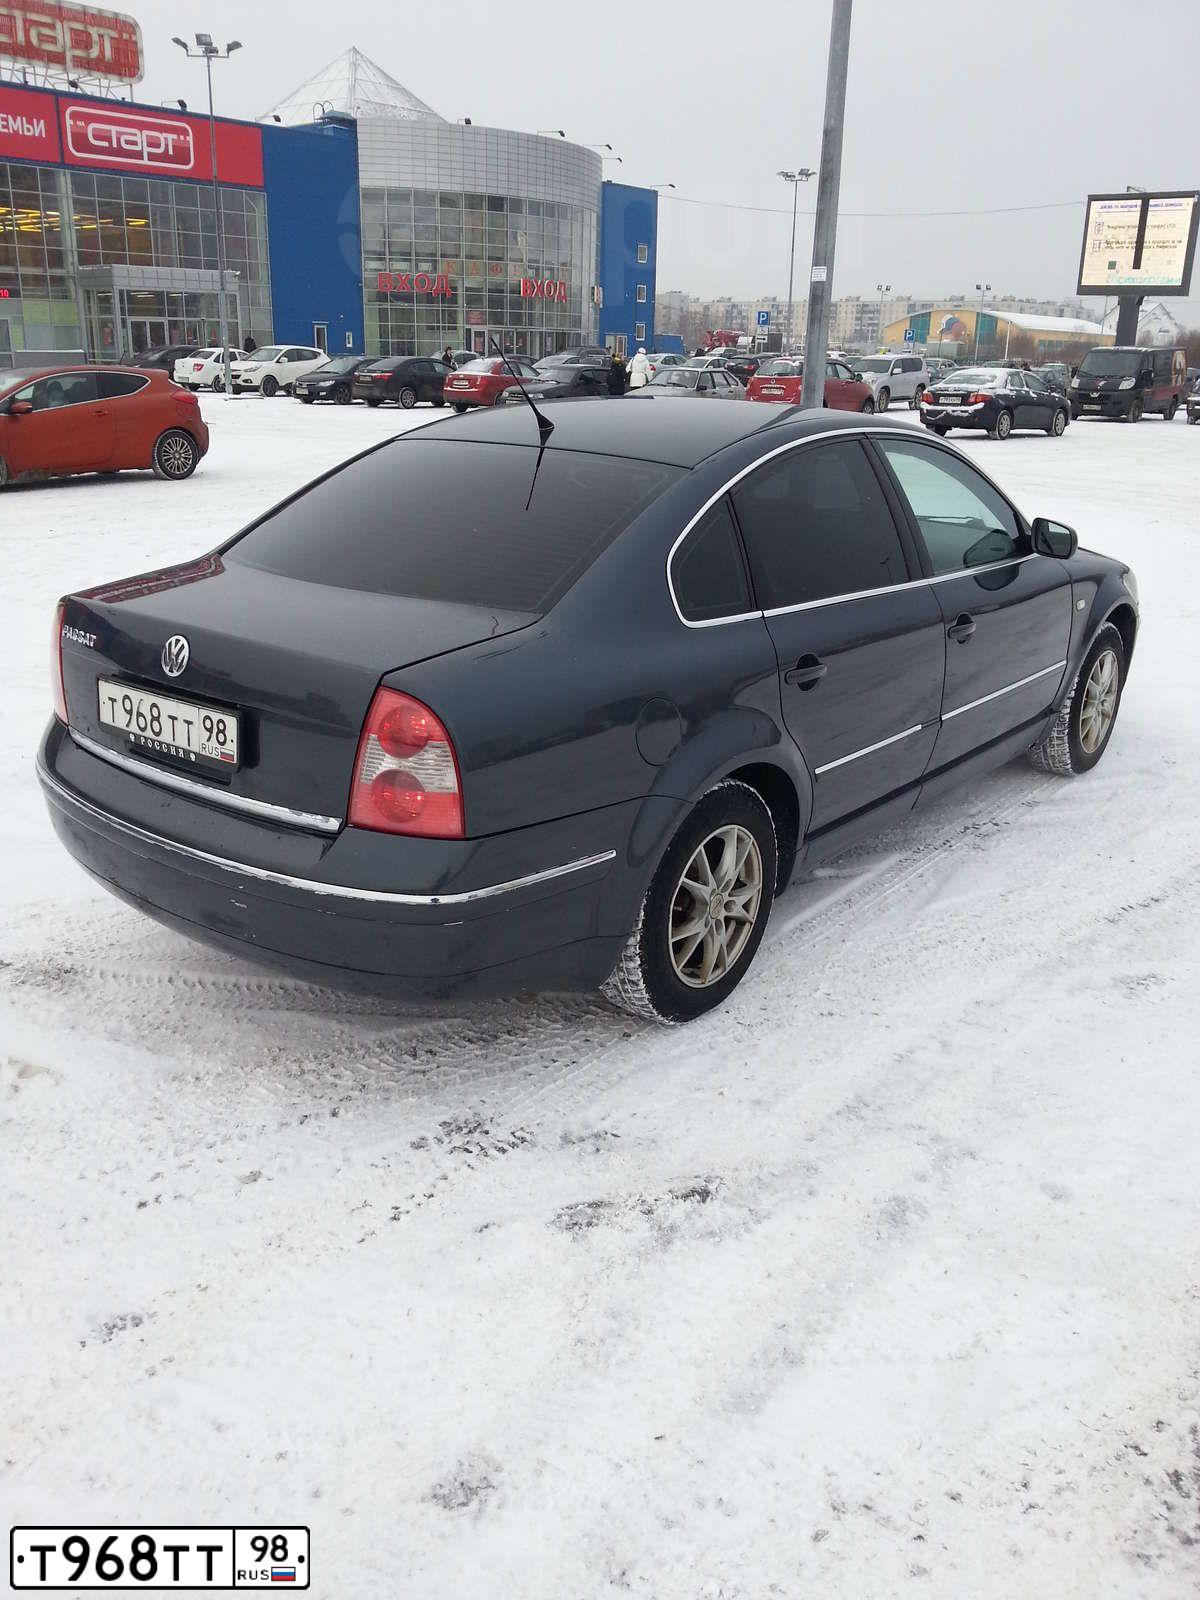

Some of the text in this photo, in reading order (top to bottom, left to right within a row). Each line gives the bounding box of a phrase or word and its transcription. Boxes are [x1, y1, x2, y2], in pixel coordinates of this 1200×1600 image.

[87, 122, 178, 162] старт
[377, 271, 452, 297] ВХОД
[520, 278, 567, 303] ВХОД
[202, 714, 228, 746] 98
[201, 742, 220, 757] RUS
